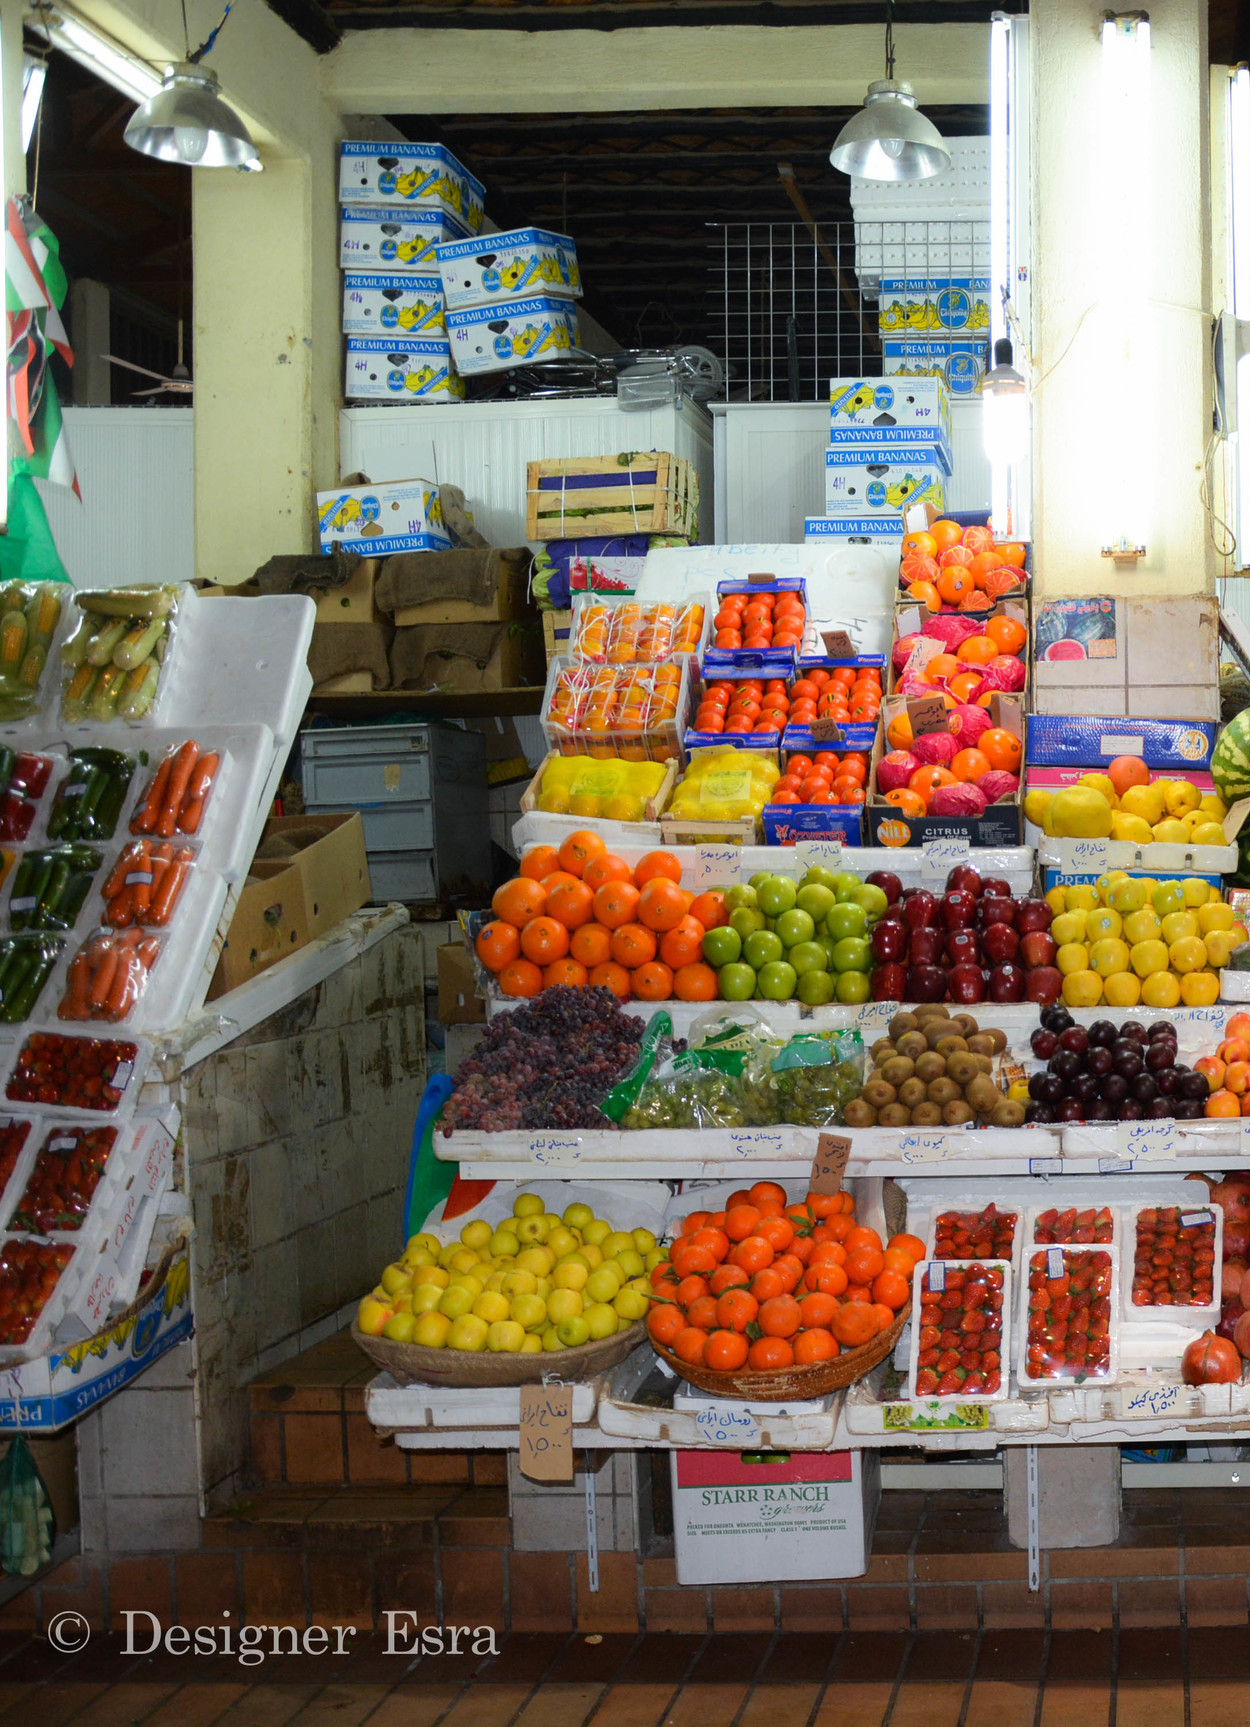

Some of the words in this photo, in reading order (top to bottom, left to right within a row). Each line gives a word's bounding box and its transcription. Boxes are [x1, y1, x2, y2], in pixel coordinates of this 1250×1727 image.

[345, 143, 389, 153] PREMIUM
[391, 145, 437, 156] BANANAS
[438, 242, 484, 259] PREMIUM
[485, 233, 530, 250] BANANAS
[346, 277, 391, 287] PREMIUM
[393, 278, 438, 288] BANANAS
[893, 281, 937, 289] PREMIUM
[449, 308, 496, 326] PREMIUM
[497, 301, 543, 318] BANANAS
[456, 328, 469, 342] 4H
[350, 340, 396, 351] PREMIUM
[398, 342, 445, 352] BANANAS
[900, 345, 946, 354] PREMIUM
[834, 430, 883, 441] BANANAS
[886, 429, 935, 440] PREMIUM
[827, 451, 875, 463] PREMIUM
[877, 451, 927, 462] BANANAS
[832, 476, 846, 490] 4H
[809, 521, 858, 533] PREMIUM
[325, 543, 373, 553] BANANS
[375, 536, 424, 550] PREMIUM
[701, 1489, 759, 1506] STARR
[764, 1486, 830, 1502] RANCH
